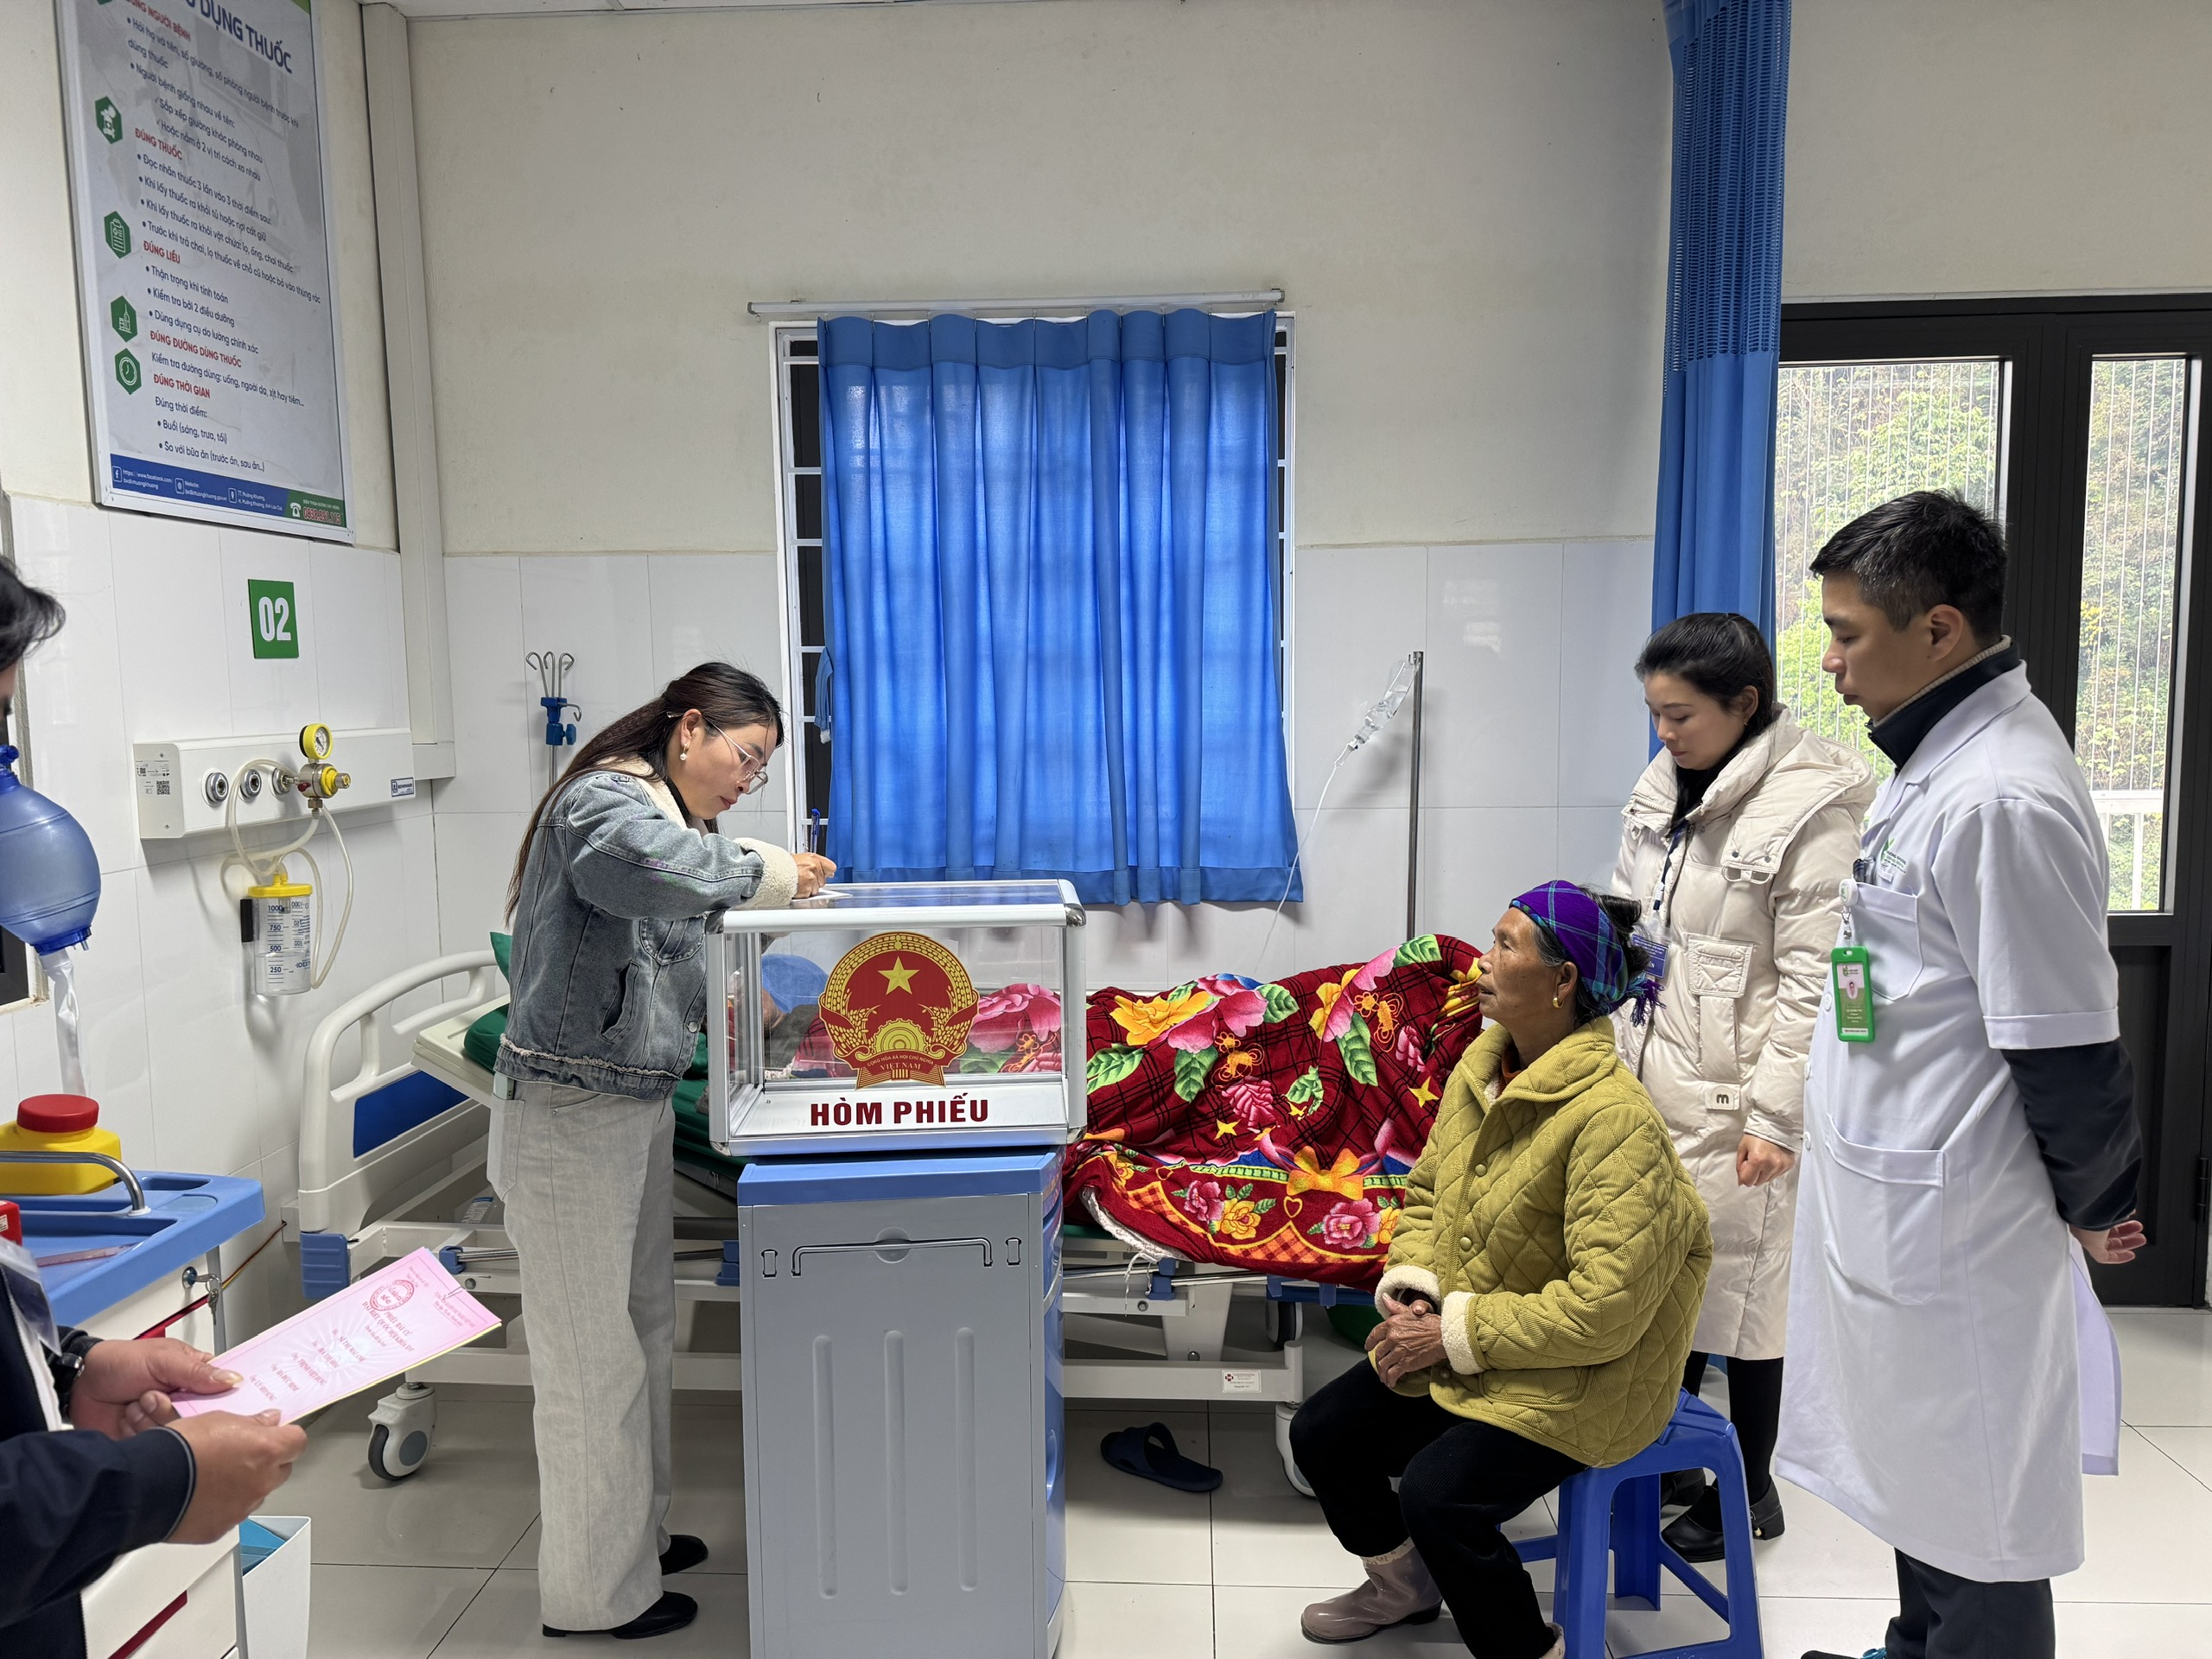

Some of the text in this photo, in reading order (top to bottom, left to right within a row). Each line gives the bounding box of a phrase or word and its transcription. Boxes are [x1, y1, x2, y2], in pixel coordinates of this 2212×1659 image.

[200, 0, 292, 74] DỤNG THUỐC
[196, 101, 213, 117] nhau
[135, 128, 183, 161] ĐÚNG THUỐC
[143, 154, 158, 169] Đọc
[177, 172, 197, 188] thuốc
[197, 180, 202, 191] 3
[226, 195, 232, 206] 3
[238, 162, 245, 173] xa
[144, 175, 156, 189] Khi
[156, 181, 168, 197] lấy
[168, 188, 188, 206] thuốc
[189, 200, 196, 208] ra
[146, 199, 157, 213] Khi
[158, 204, 169, 219] lấy
[170, 210, 189, 226] thuốc
[190, 221, 198, 230] ra
[143, 240, 165, 257] ĐÚNG
[148, 220, 168, 238] Trước
[168, 229, 178, 242] khi
[214, 251, 232, 266] thuốc
[151, 264, 169, 281] Thận
[169, 274, 188, 290] trọng
[189, 279, 200, 293] khi
[213, 290, 229, 304] toán
[171, 296, 181, 307] tra
[194, 302, 199, 313] 2
[155, 309, 174, 327] Dùng
[175, 316, 192, 334] dụng
[193, 325, 201, 336] cụ
[247, 343, 259, 354] xác
[149, 329, 242, 368] ĐÚNG ĐƯỜNG DÙNG THUỐC
[153, 372, 211, 399] ĐÚNG THỜI GIAN
[170, 359, 181, 370] tra
[181, 361, 203, 378] đường
[204, 368, 222, 384] dùng:
[223, 373, 241, 389] uống,
[241, 381, 258, 392] ngoài
[277, 390, 288, 404] hay
[155, 396, 175, 412] Đúng
[175, 402, 188, 414] thời
[179, 421, 200, 440] (sáng,
[200, 429, 216, 442] trưa,
[217, 431, 228, 446] tối)
[164, 440, 175, 453] So
[175, 444, 186, 455] với
[240, 460, 251, 470] sau
[258, 596, 292, 642] 02
[867, 1058, 881, 1067] CỘNG
[880, 1062, 922, 1071] VIỆT NAM
[810, 1092, 988, 1127] HÒM PHIẾU
[1716, 1093, 1730, 1104] m
